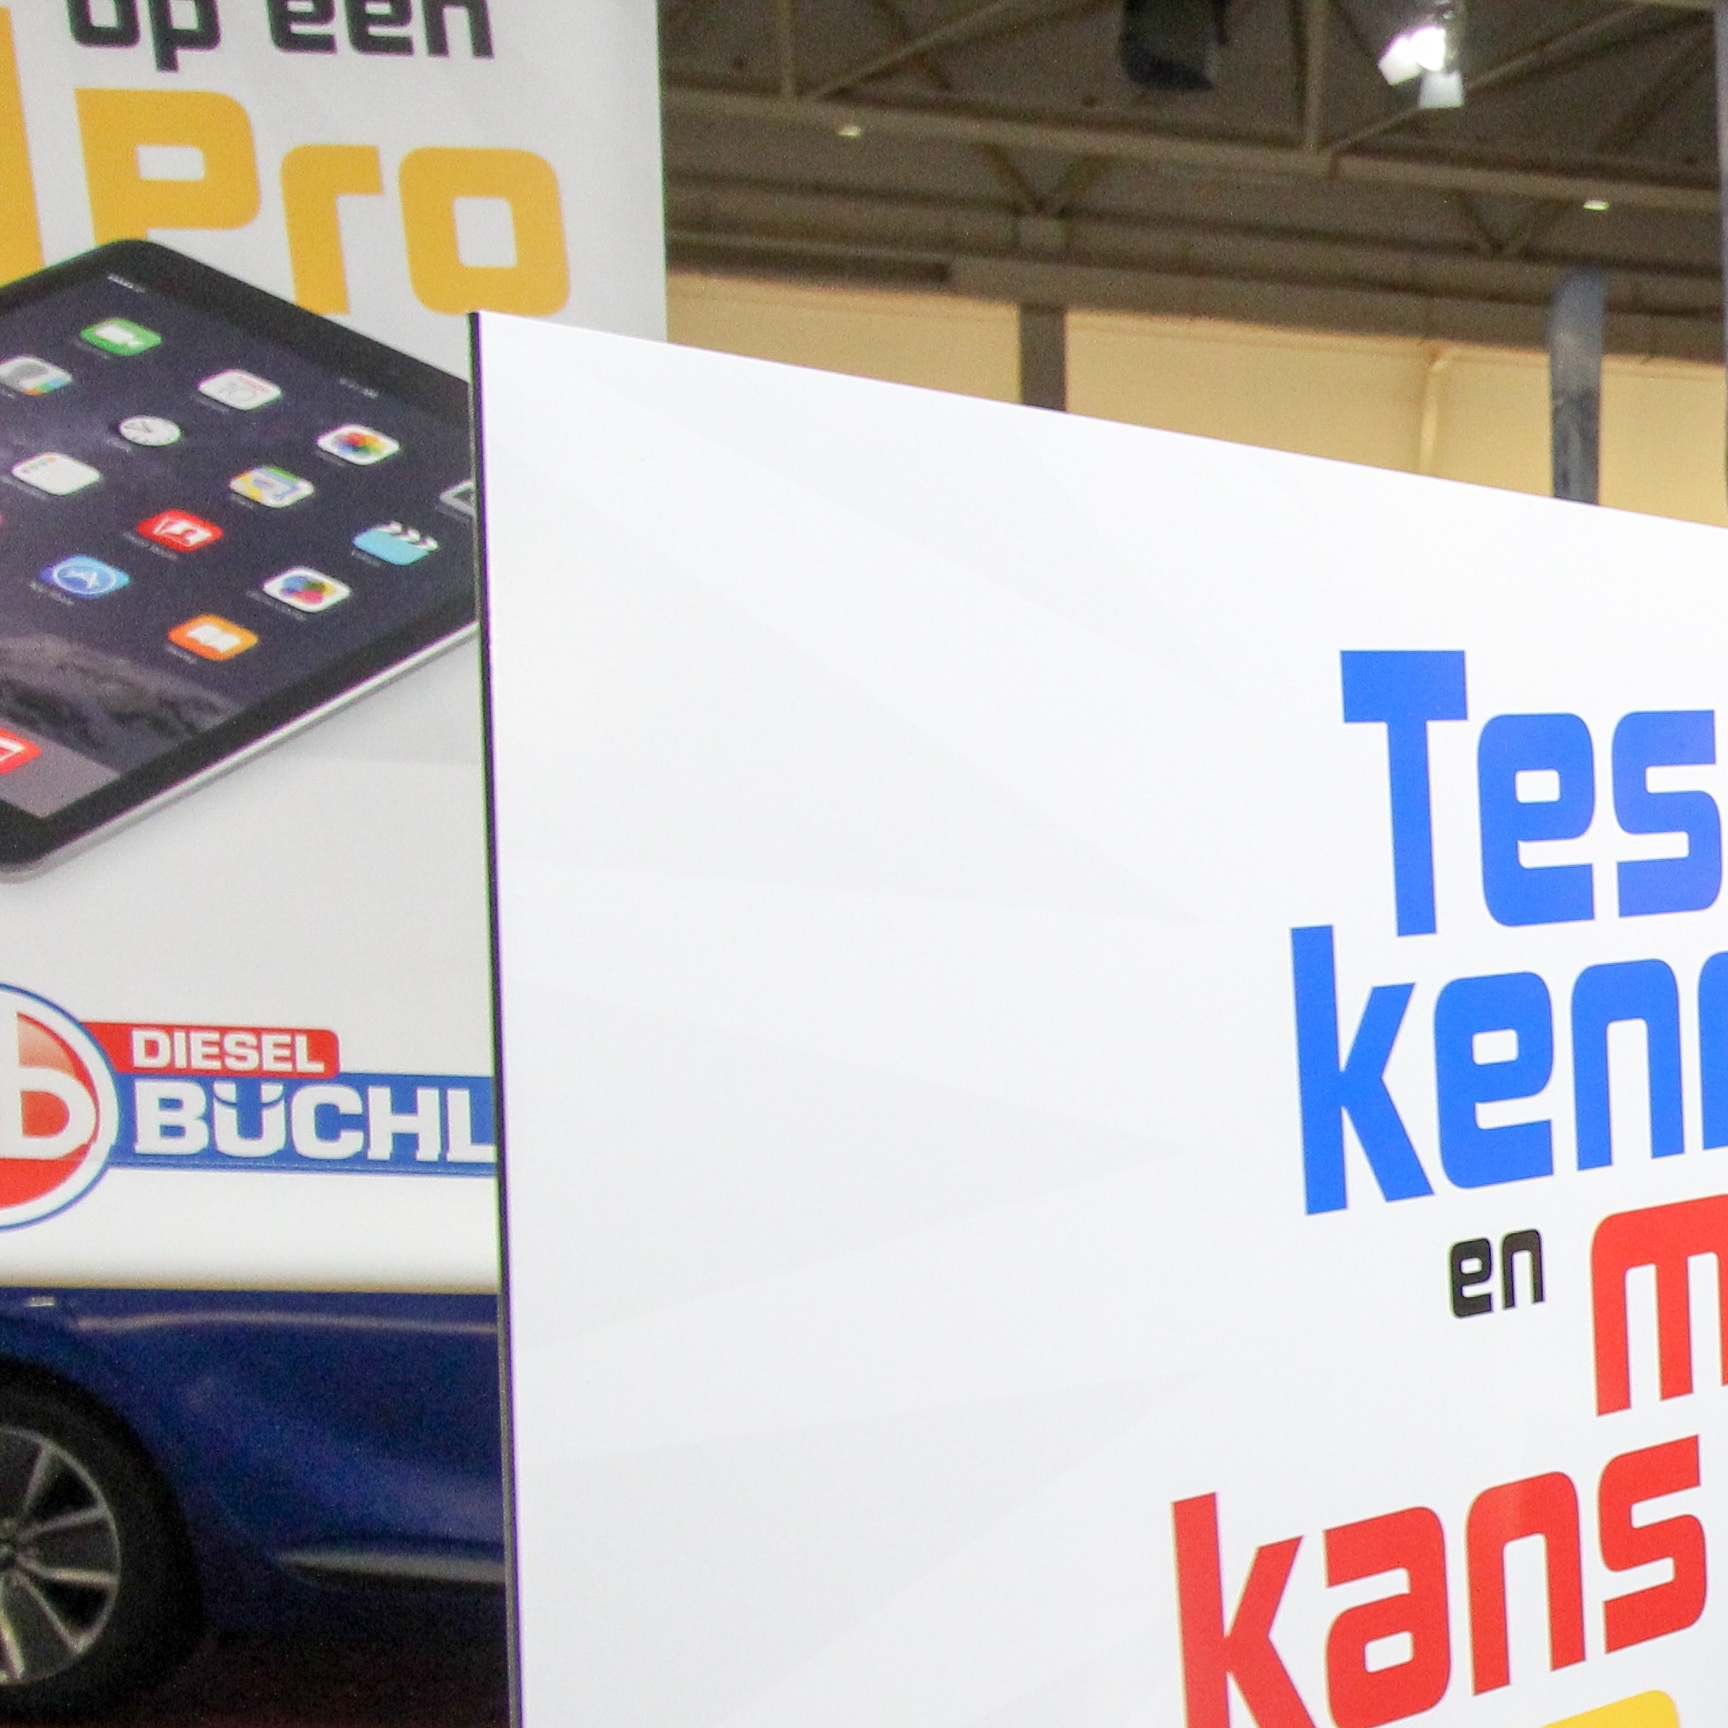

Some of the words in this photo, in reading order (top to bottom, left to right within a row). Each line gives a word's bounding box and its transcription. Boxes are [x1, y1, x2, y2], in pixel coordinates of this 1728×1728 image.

[67, 0, 222, 72] op
[268, 0, 495, 59] een
[75, 87, 571, 317] Pro
[131, 1029, 326, 1074] DIESEL
[1449, 1228, 1545, 1318] en
